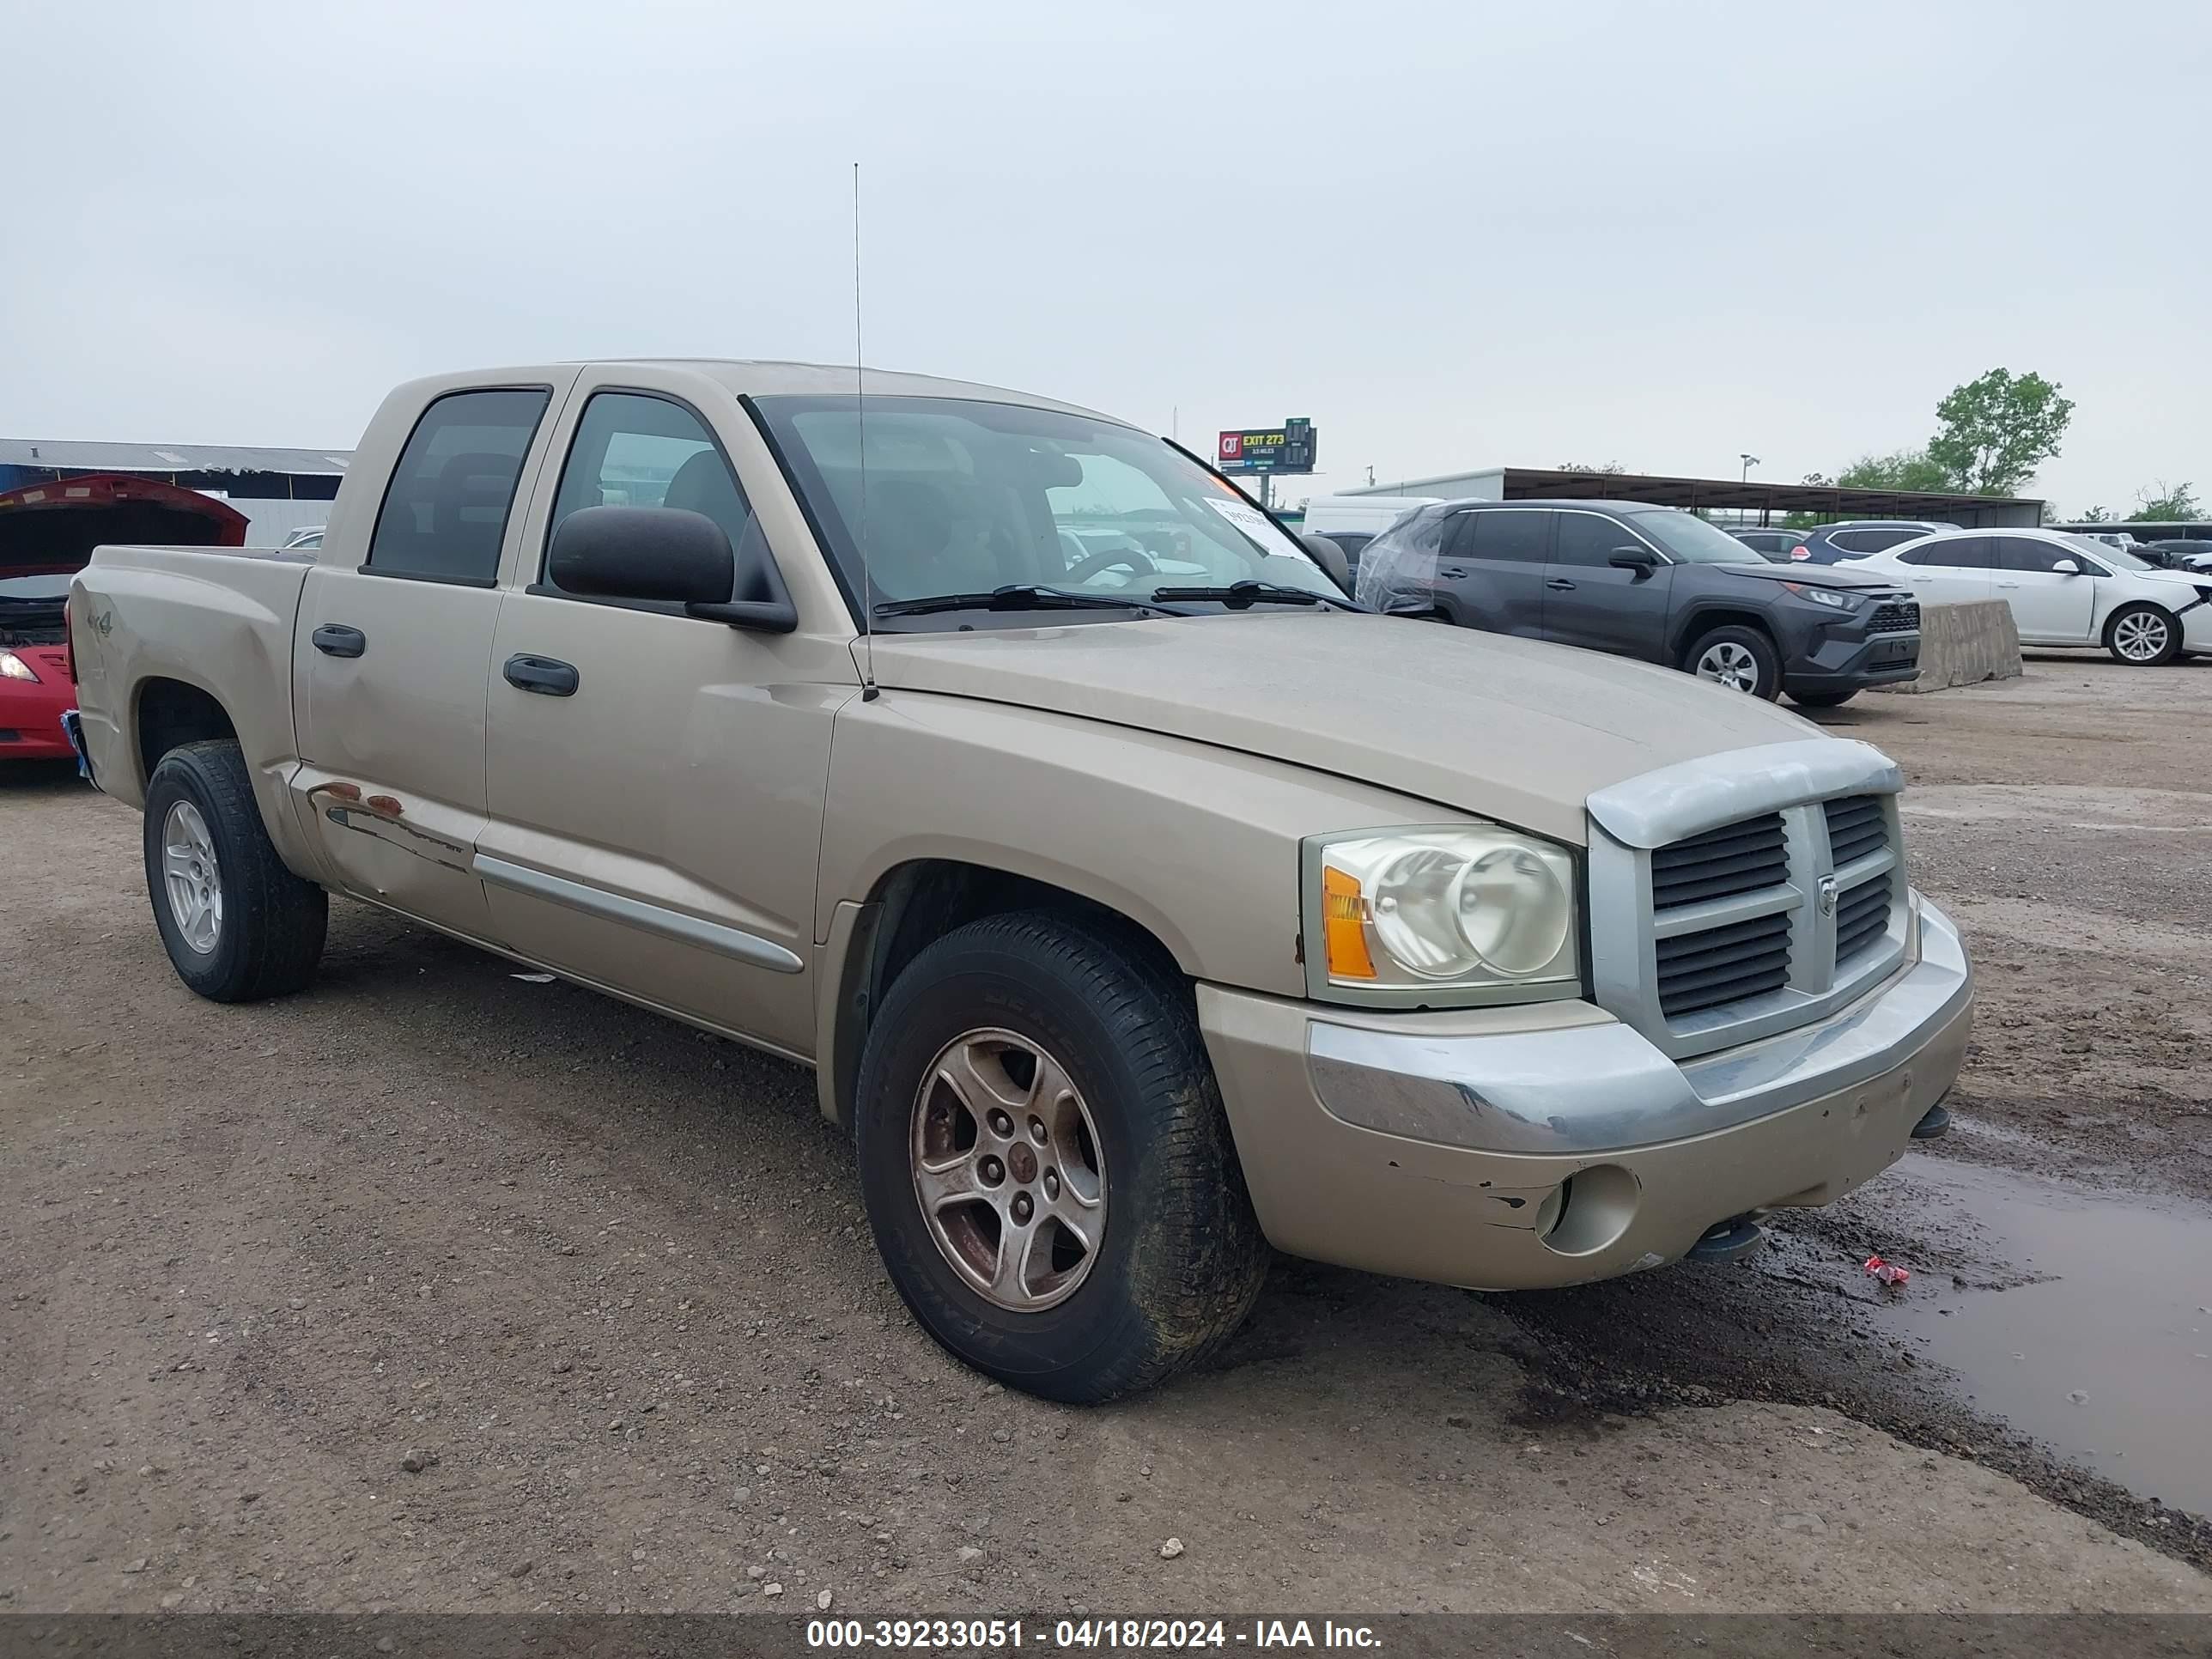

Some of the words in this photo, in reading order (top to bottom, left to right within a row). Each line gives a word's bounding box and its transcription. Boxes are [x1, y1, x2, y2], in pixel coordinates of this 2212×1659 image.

[1222, 436, 1238, 454] QT
[1243, 435, 1265, 447] EXIT
[1266, 434, 1285, 446] 273
